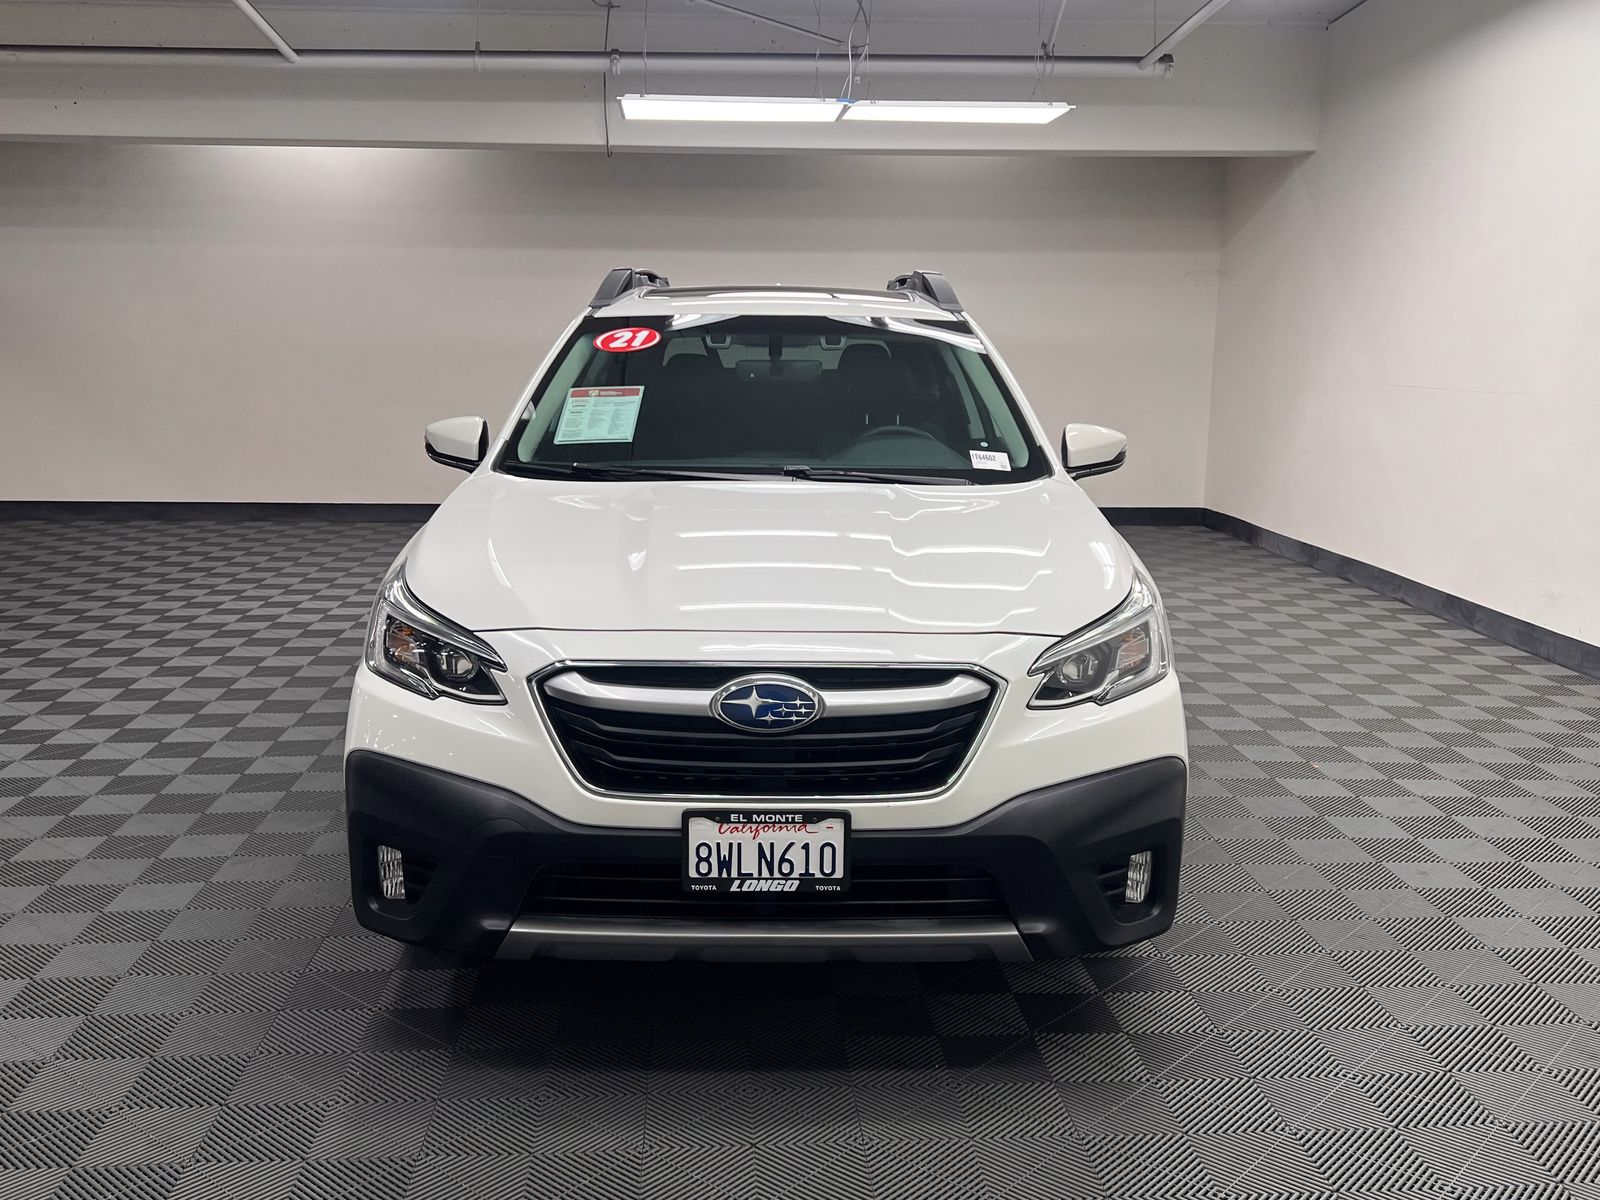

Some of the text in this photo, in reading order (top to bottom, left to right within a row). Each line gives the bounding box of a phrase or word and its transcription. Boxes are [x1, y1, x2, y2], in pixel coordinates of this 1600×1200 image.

[609, 330, 650, 348] 21
[730, 813, 803, 822] EL MONTE
[718, 823, 818, 840] California
[695, 842, 837, 877] 8WLN610
[730, 879, 800, 892] LONGO
